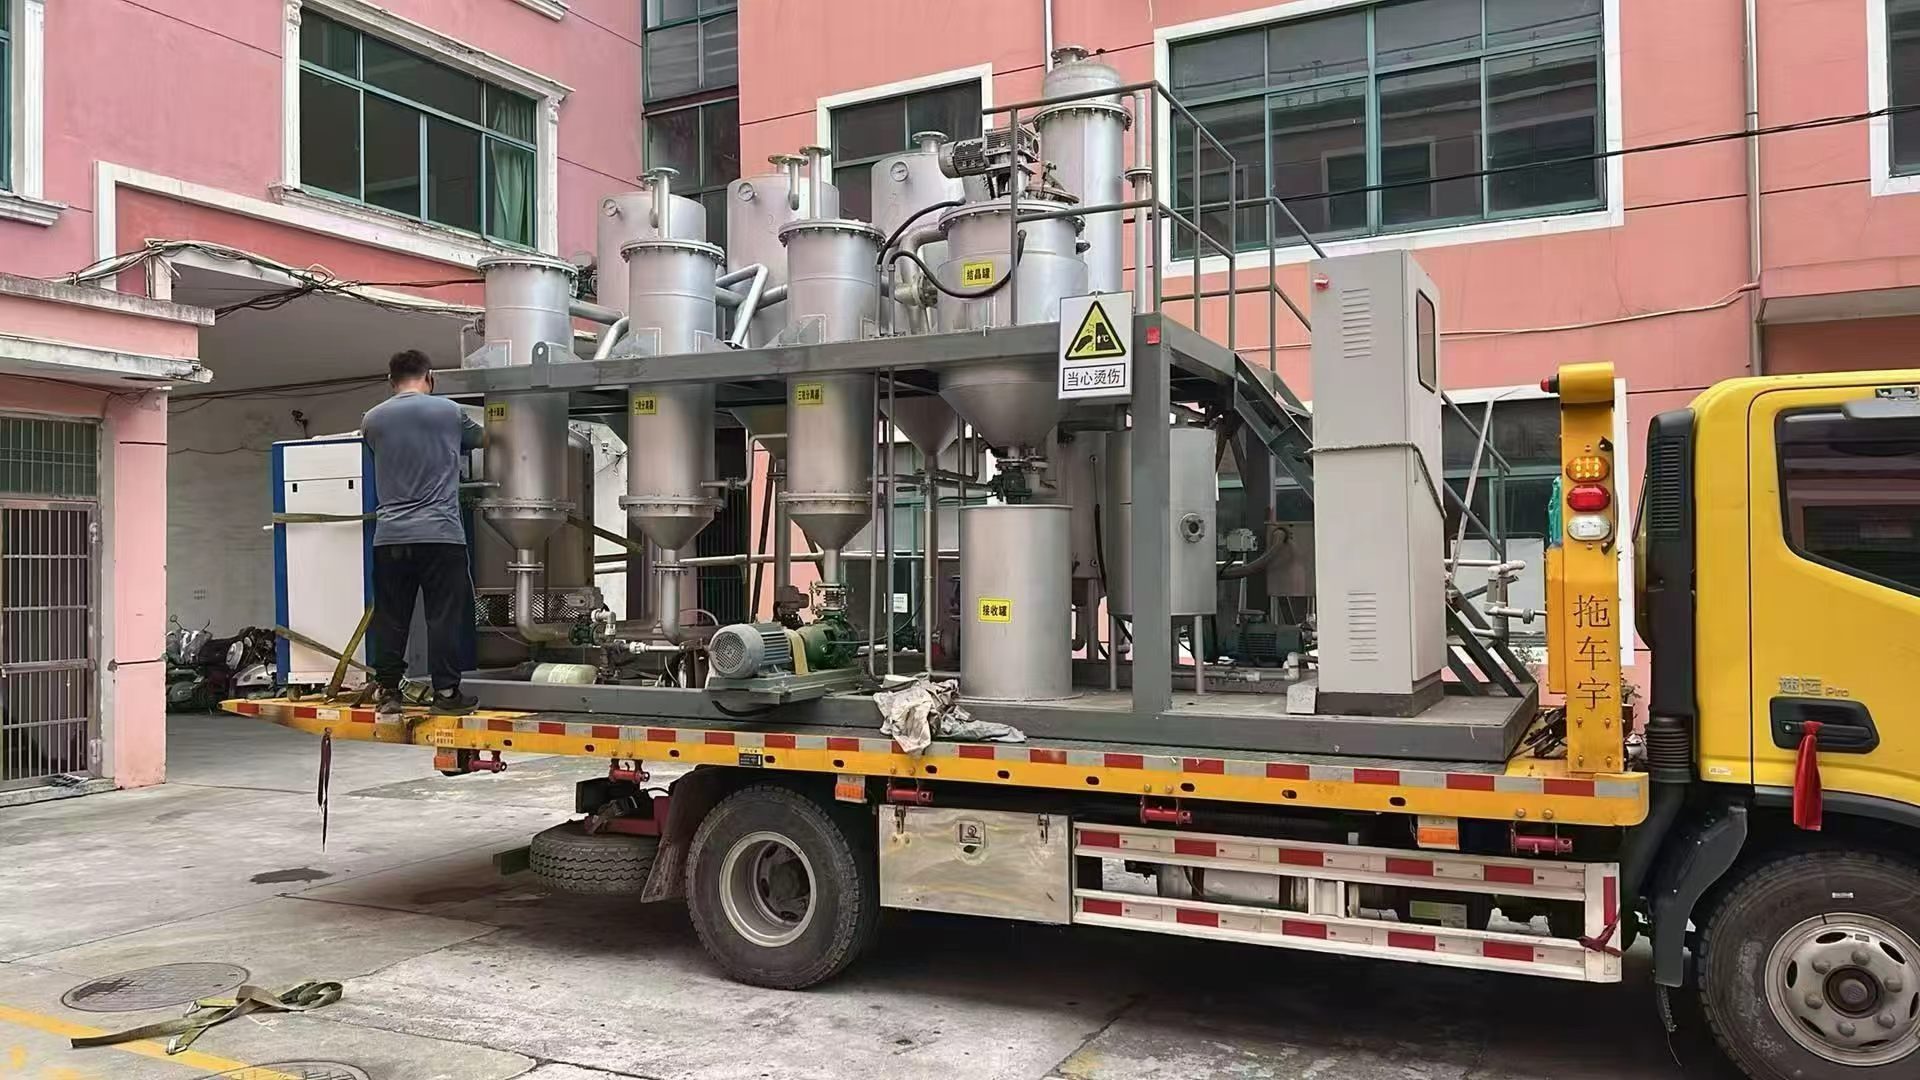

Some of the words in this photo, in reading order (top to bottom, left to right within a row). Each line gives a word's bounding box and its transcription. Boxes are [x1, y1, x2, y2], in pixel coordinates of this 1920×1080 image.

[967, 267, 990, 280] 结晶罐
[1067, 368, 1121, 386] 当心烫伤
[983, 604, 1007, 616] 接收罐
[1572, 594, 1612, 712] 拖车宇
[1825, 687, 1850, 698] Pro
